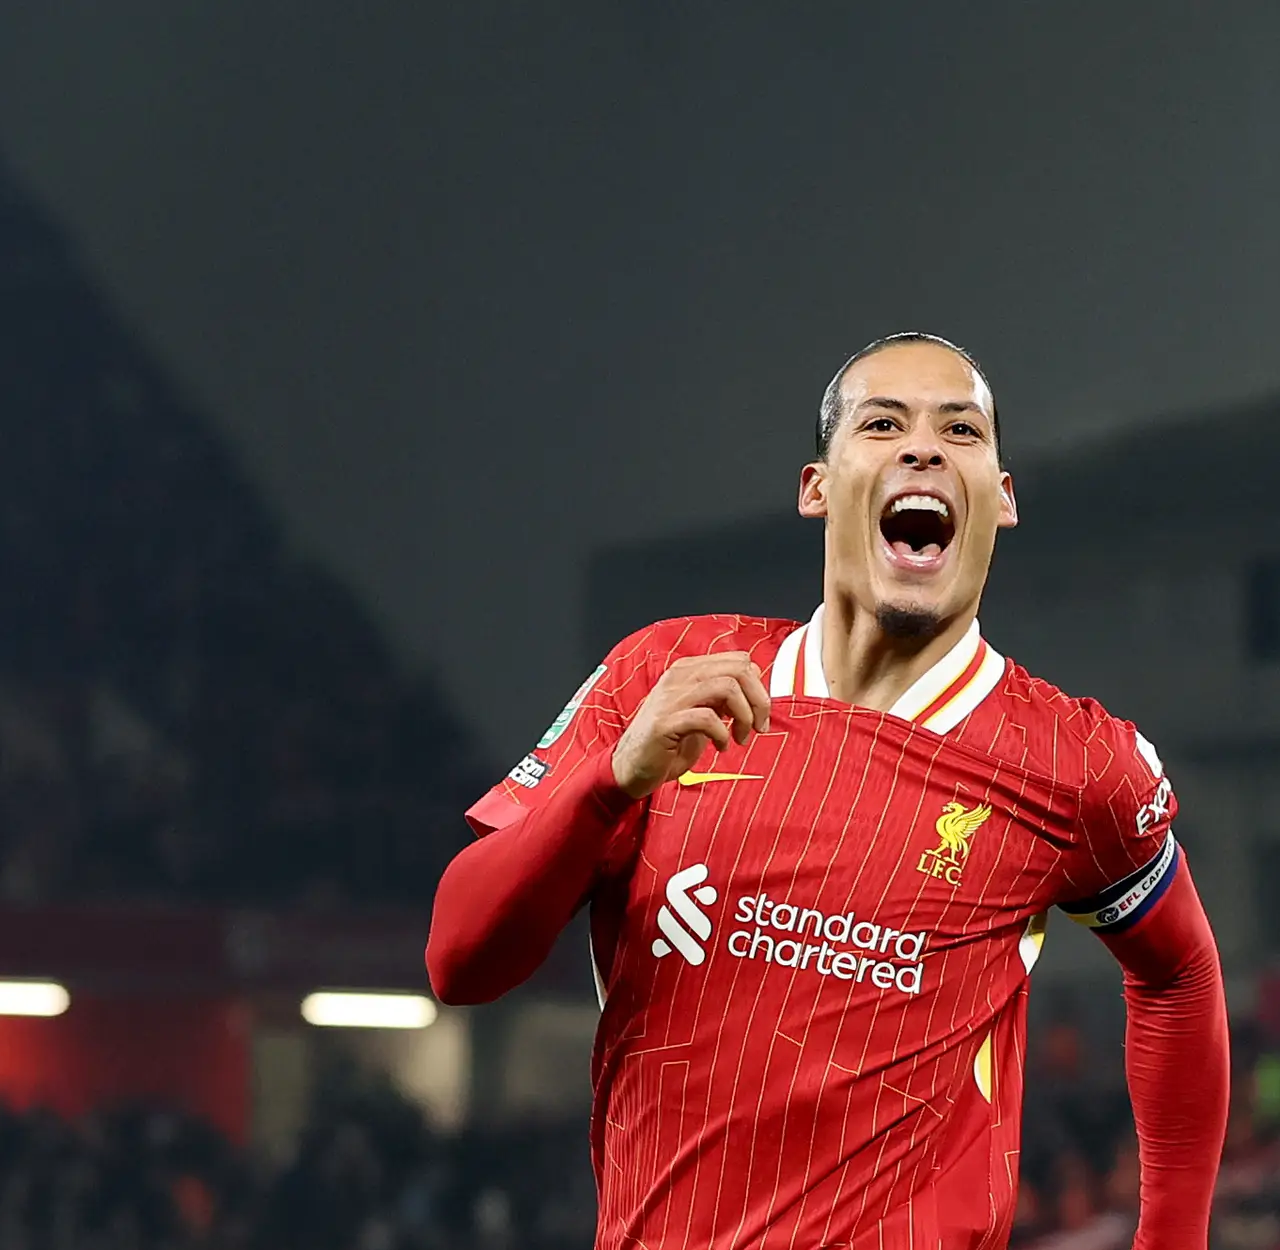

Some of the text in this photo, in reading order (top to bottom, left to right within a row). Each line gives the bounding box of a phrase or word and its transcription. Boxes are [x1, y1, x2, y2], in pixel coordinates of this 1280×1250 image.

[734, 893, 927, 962] standard
[1118, 890, 1142, 912] EFL
[728, 927, 924, 994] chartered
